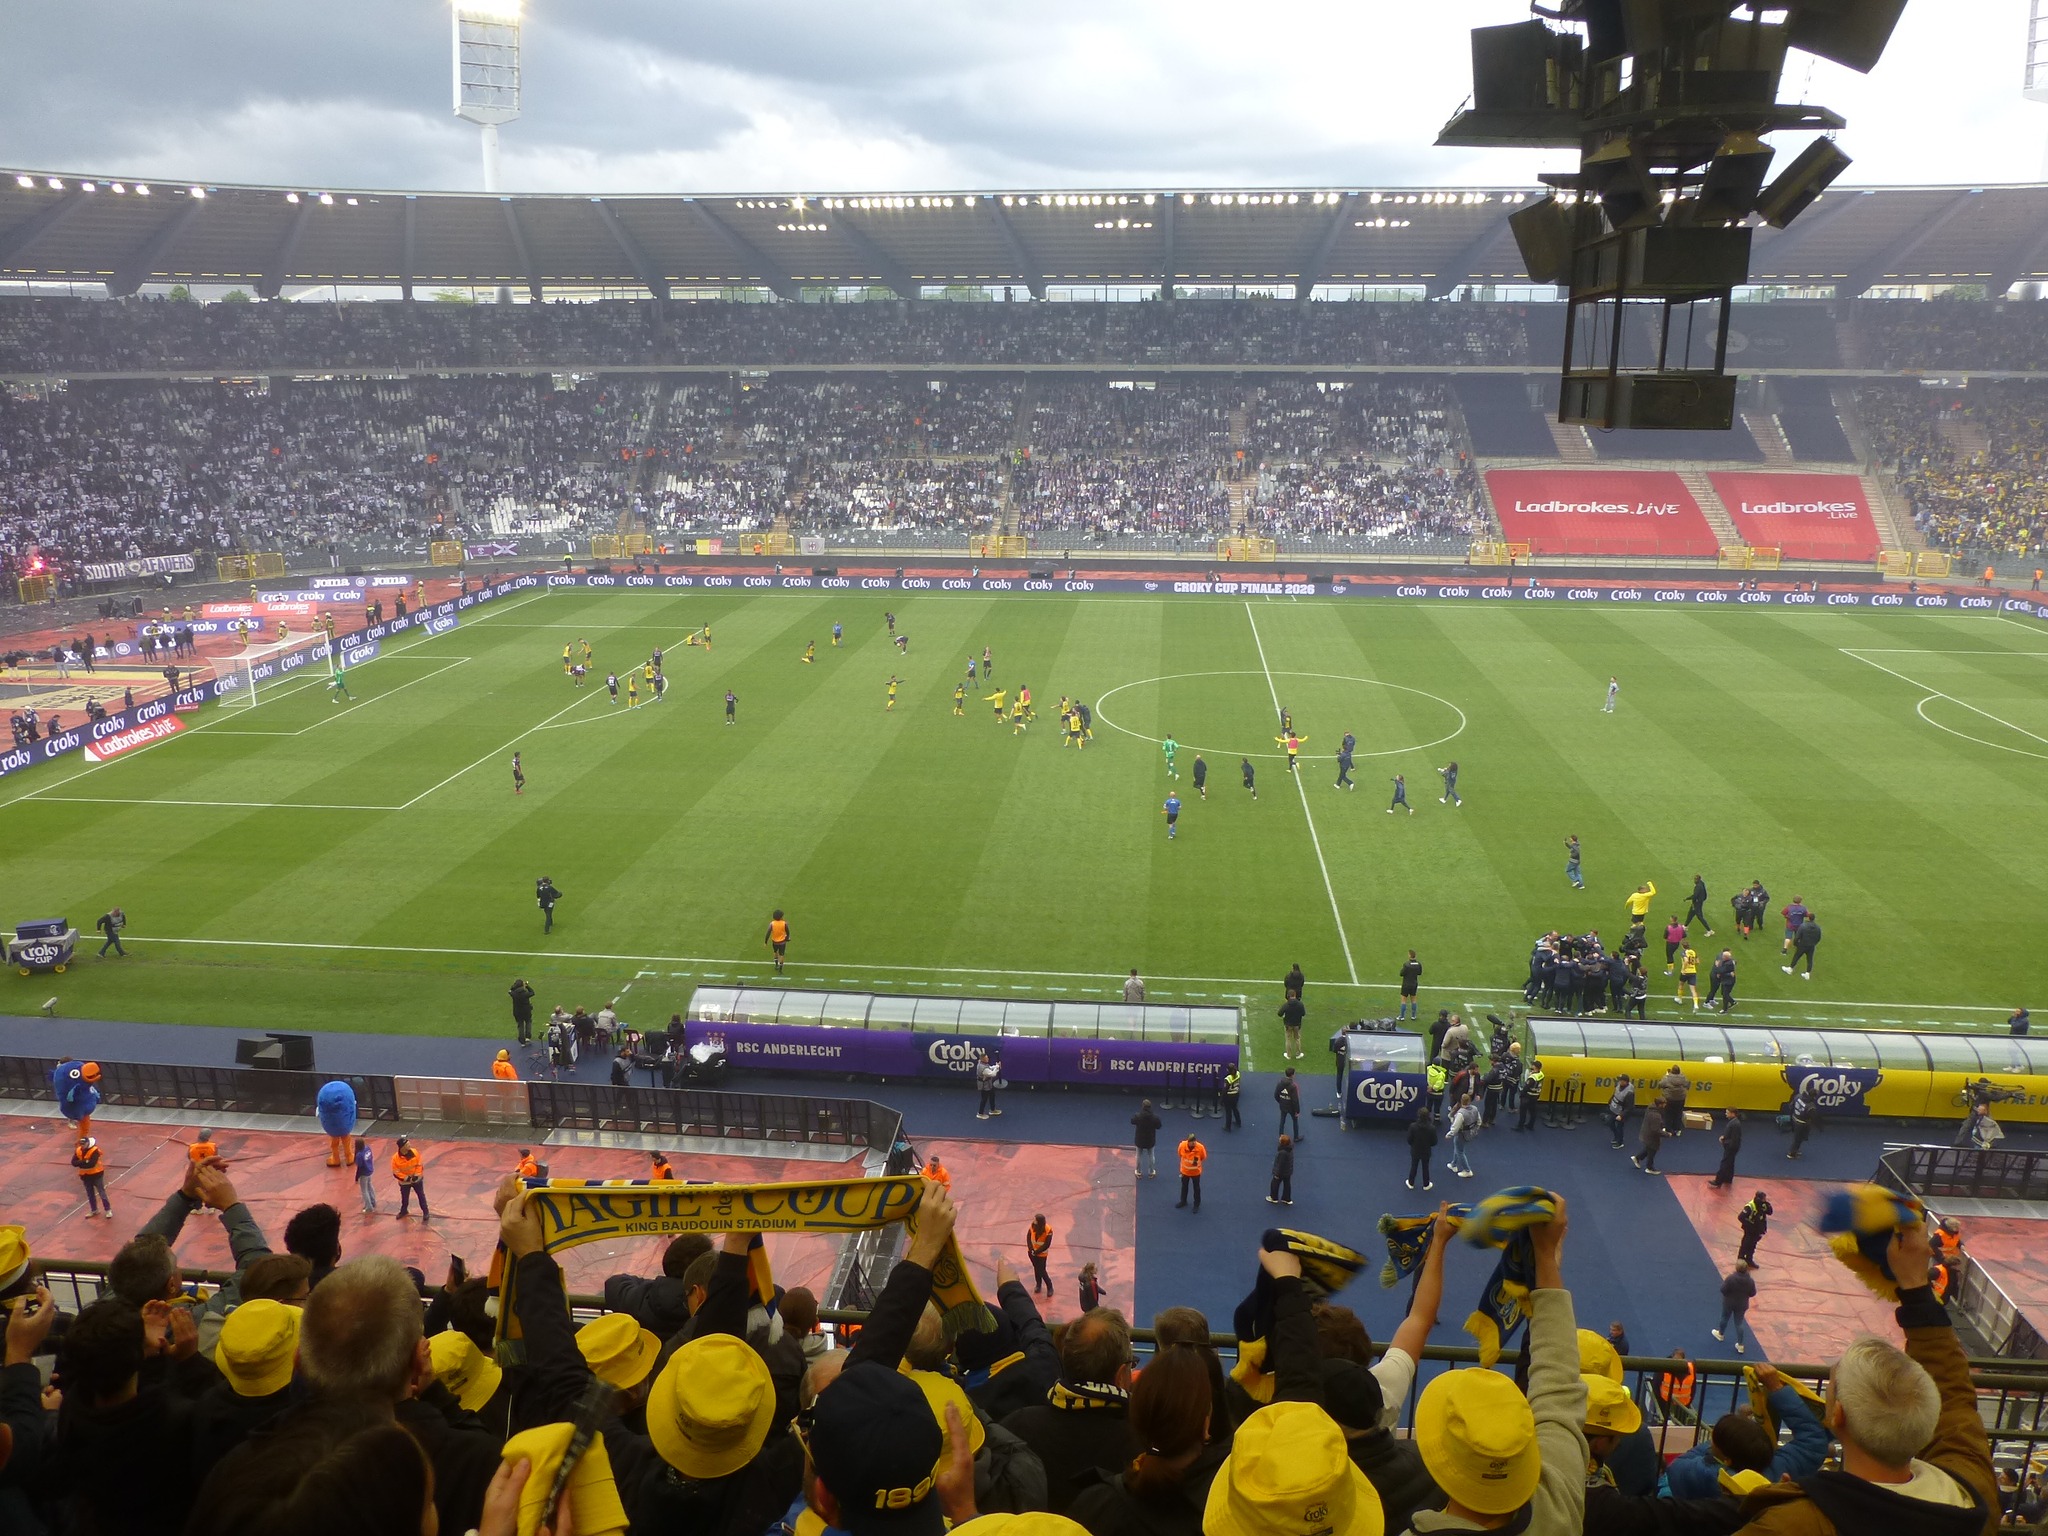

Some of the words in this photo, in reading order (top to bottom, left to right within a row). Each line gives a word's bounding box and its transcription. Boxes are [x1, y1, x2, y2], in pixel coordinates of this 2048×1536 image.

[1741, 501, 1856, 514] Ladbrokes
[84, 562, 126, 580] SOUTH
[144, 556, 194, 572] LEADERS
[548, 575, 576, 586] Croky
[587, 575, 615, 586] Croky
[626, 575, 654, 586] Croky
[665, 576, 693, 587] Croky
[704, 576, 732, 587] Croky
[743, 576, 772, 588] Croky
[783, 577, 811, 588] Croky
[822, 578, 850, 588] Croky
[862, 578, 890, 589] Croky
[902, 578, 930, 589] Croky
[942, 579, 971, 590] Croky
[983, 579, 1012, 590] Croky
[1024, 580, 1053, 591] Croky
[1065, 580, 1094, 591] Croky
[1174, 582, 1212, 593] CROKY
[1215, 583, 1238, 593] CUP
[1241, 583, 1282, 594] FINALE
[1285, 584, 1315, 594] 2026
[262, 592, 289, 602] Croky
[297, 590, 325, 602] Croky
[333, 589, 360, 601] Croky
[1396, 585, 1426, 597] Croky
[1439, 586, 1469, 598] Croky
[1482, 586, 1512, 598] Croky
[1524, 587, 1555, 599] Croky
[1567, 588, 1598, 600] Croky
[1610, 588, 1642, 601] Croky
[1654, 589, 1685, 601] Croky
[1696, 590, 1727, 602] Croky
[1740, 591, 1771, 603] Croky
[1784, 592, 1815, 604] Croky
[1827, 593, 1859, 605] Croky
[1872, 594, 1903, 606] Croky
[1916, 595, 1947, 607] Croky
[1960, 596, 1992, 608] Croky
[210, 604, 253, 613] Ladbrokes
[267, 602, 310, 611] Ladbrokes
[142, 624, 175, 636] Coky
[433, 616, 454, 632] Croky
[350, 644, 374, 664] Croky
[45, 732, 80, 758] Croky
[92, 716, 124, 740] Croky
[137, 700, 166, 724] Croky
[281, 653, 304, 672] Croky
[340, 632, 360, 651] Croky
[366, 624, 385, 642] Croky
[391, 617, 409, 633] Croky
[415, 608, 432, 624] Croky
[438, 601, 454, 617] Croky
[458, 595, 473, 610] Croky
[478, 588, 493, 603] Croky
[497, 582, 512, 596] Croky
[516, 575, 537, 589] Croky
[21, 944, 58, 960] Croky
[35, 956, 53, 964] CUP
[737, 1042, 759, 1053] RSC
[764, 1044, 842, 1057] ANDERLECHT
[948, 1061, 975, 1071] CUP
[1110, 1060, 1134, 1070] RSC
[1357, 1078, 1418, 1103] Croky
[1696, 1082, 1712, 1091] SG
[1799, 1073, 1861, 1097] Croky
[1376, 1100, 1404, 1112] CUP
[1817, 1096, 1846, 1106] CUP
[743, 1182, 924, 1220] COUP
[626, 1222, 658, 1233] KING
[662, 1219, 733, 1231] BAUDOUIN
[736, 1219, 796, 1229] STADIUM
